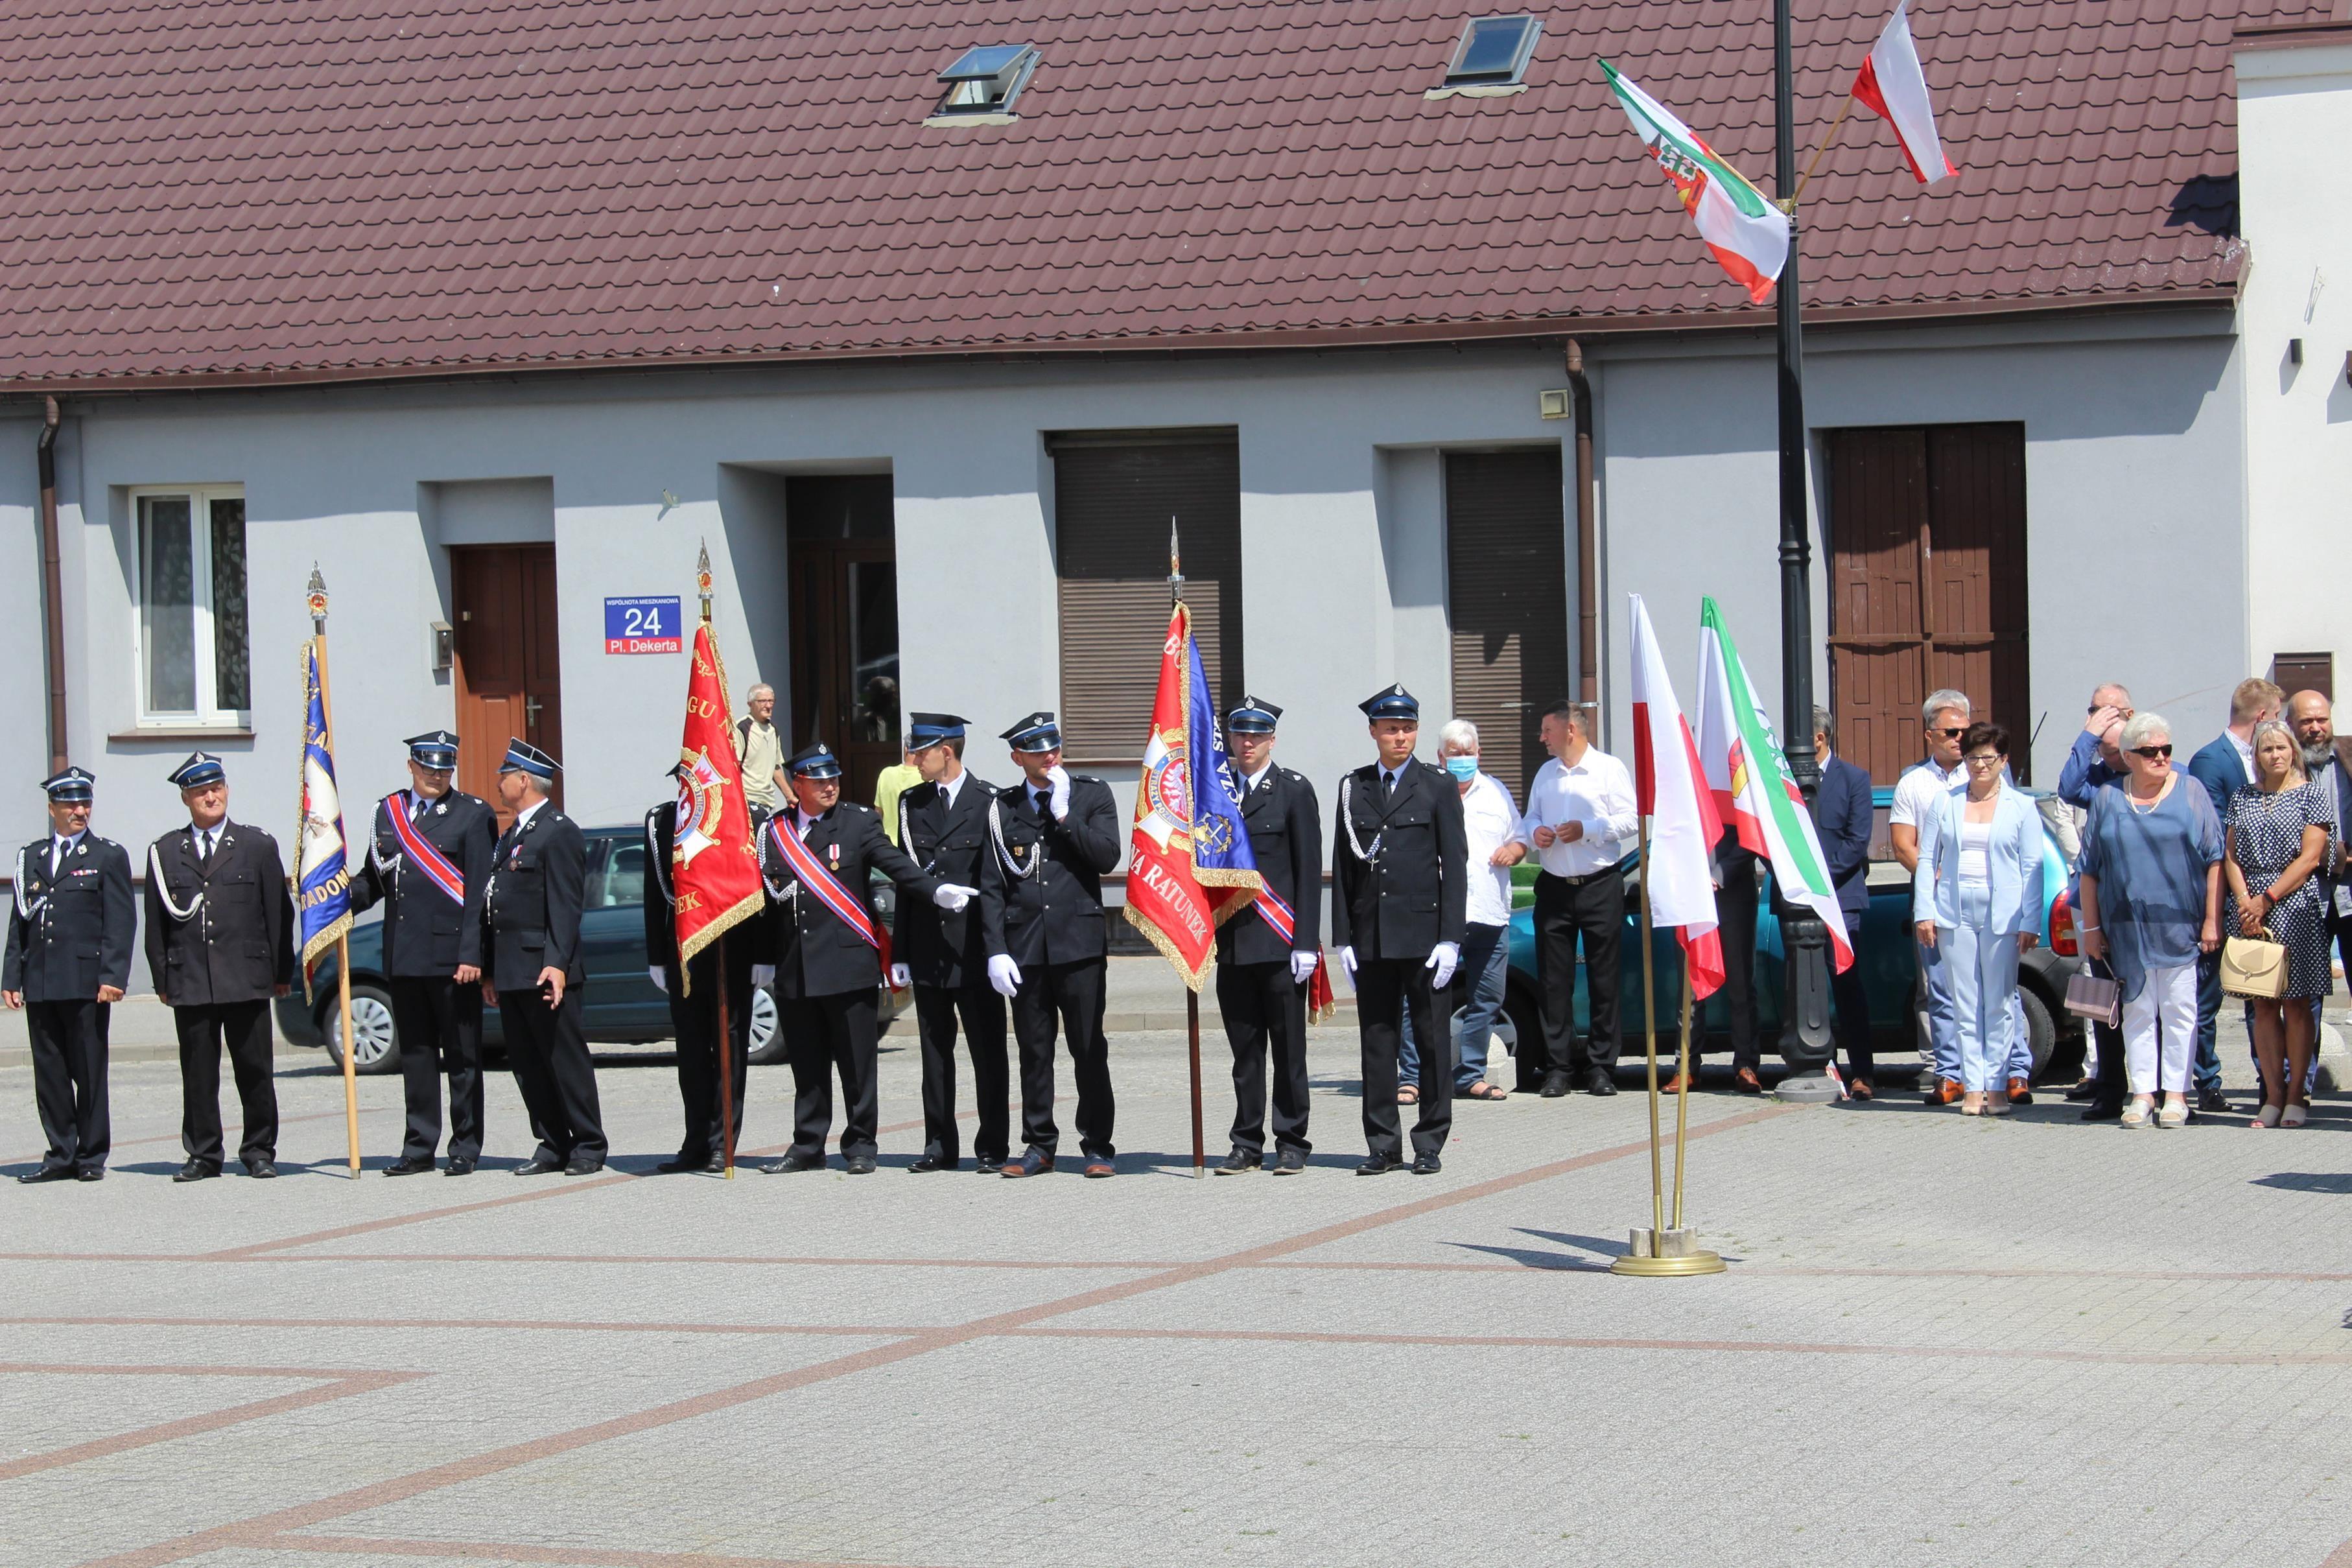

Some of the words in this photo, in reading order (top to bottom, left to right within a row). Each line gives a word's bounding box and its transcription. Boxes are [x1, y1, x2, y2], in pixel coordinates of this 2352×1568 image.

[625, 607, 661, 636] 24
[611, 640, 626, 652] Pl.
[630, 640, 677, 652] Dekerta
[1142, 863, 1208, 946] RATUNEK
